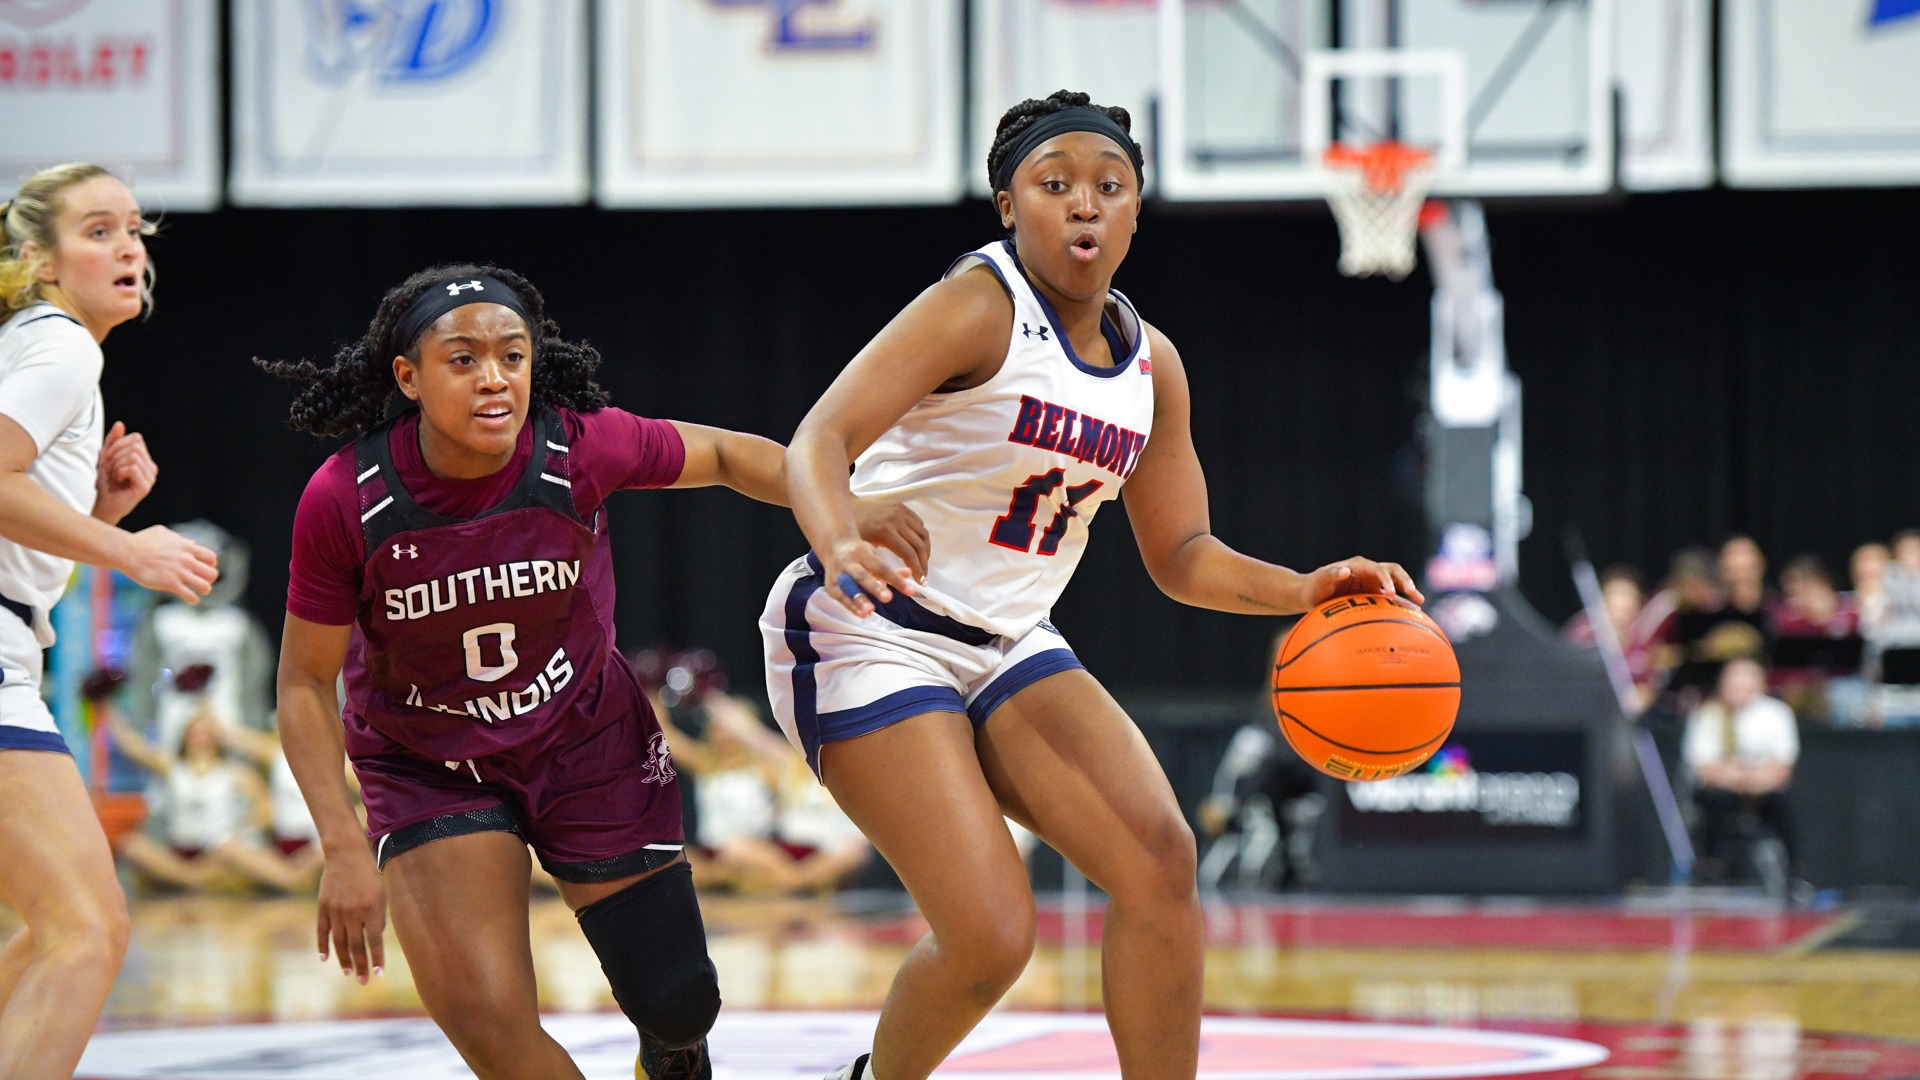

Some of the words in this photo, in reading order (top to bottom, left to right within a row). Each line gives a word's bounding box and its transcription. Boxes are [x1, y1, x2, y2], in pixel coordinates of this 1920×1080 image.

[1008, 394, 1147, 480] BELMONT
[385, 560, 580, 621] SOUTHERN
[1321, 596, 1402, 618] ELI
[463, 622, 519, 682] 0
[405, 647, 575, 725] IINOIS
